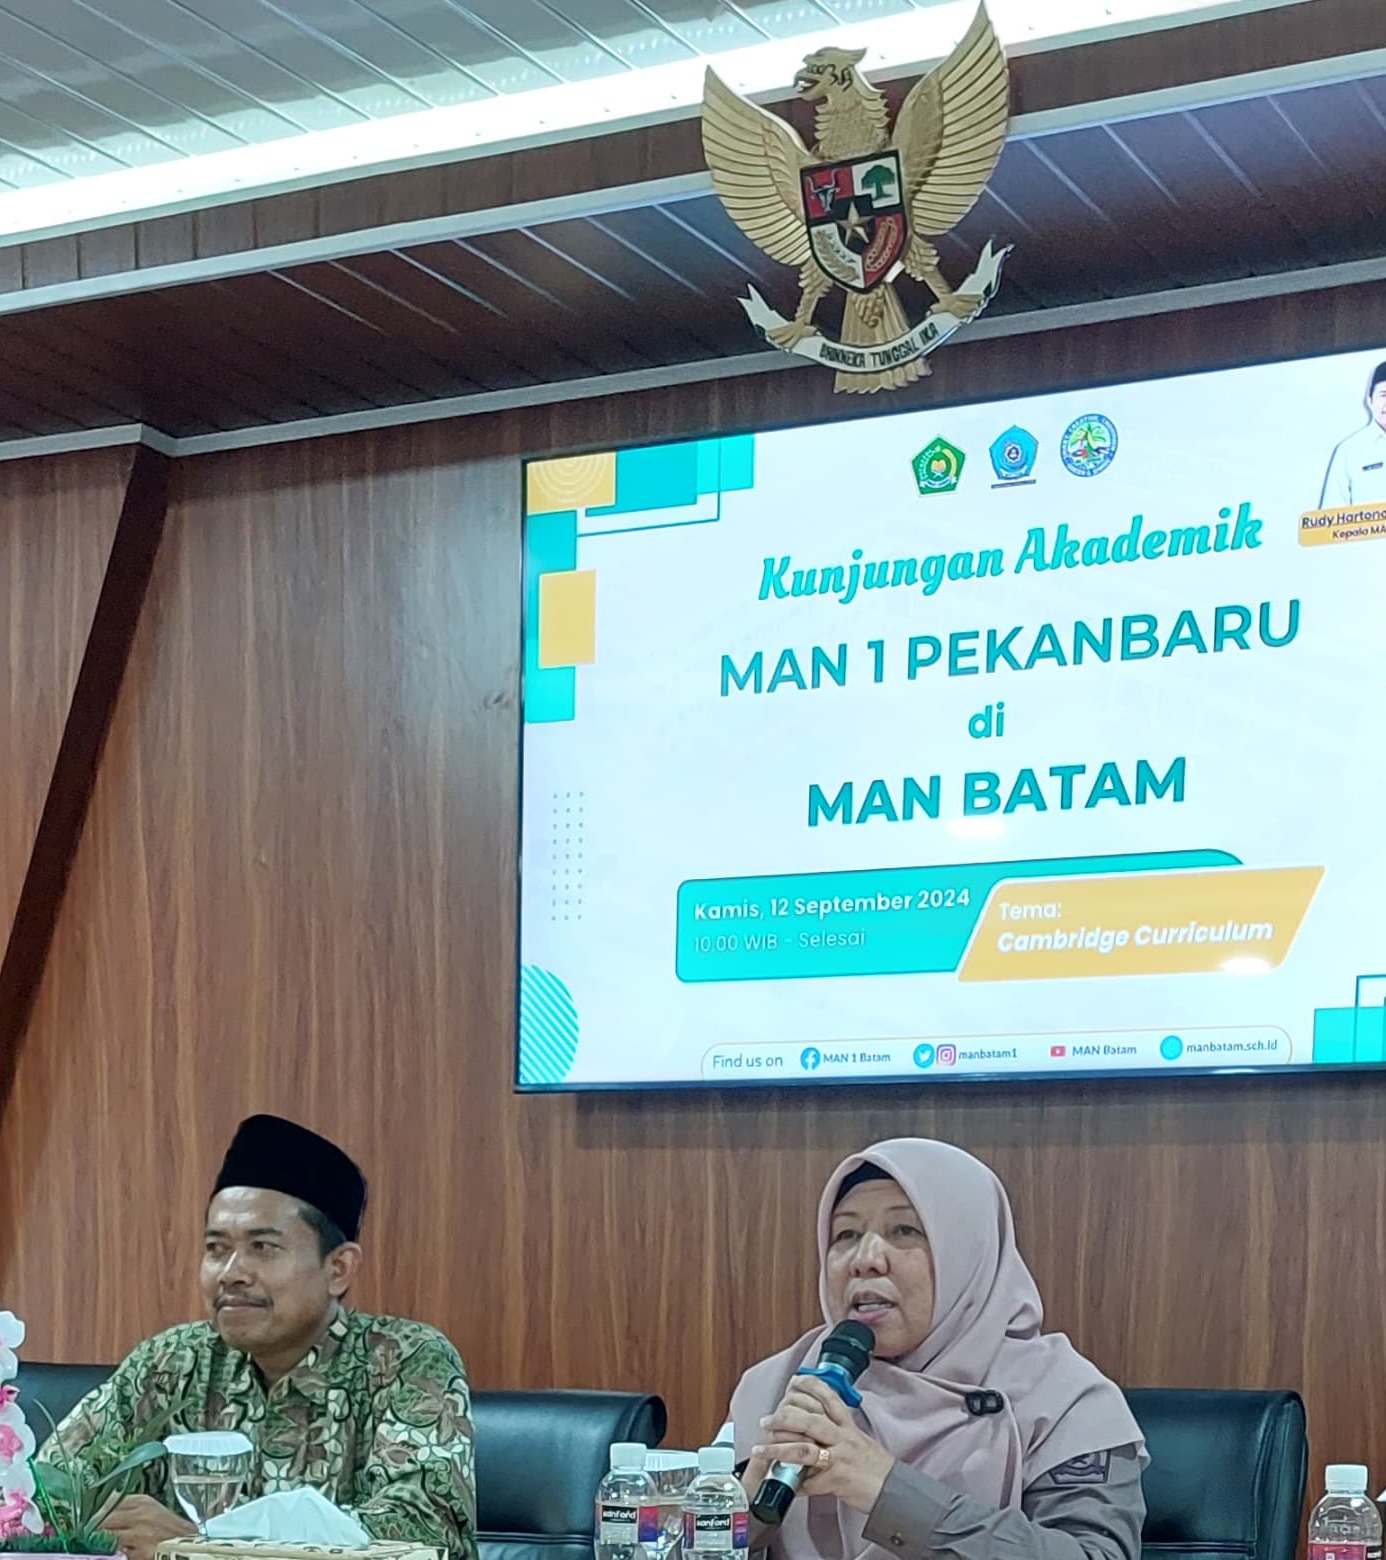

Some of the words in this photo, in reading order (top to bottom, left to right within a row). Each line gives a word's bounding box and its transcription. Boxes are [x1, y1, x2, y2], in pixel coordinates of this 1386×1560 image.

[1301, 514, 1335, 529] Rudy
[1332, 526, 1369, 541] Kepala
[759, 548, 1004, 605] Kunjungan
[1014, 502, 1264, 574] Akademik
[720, 642, 848, 697] MAN
[867, 639, 885, 683] 1
[907, 599, 1301, 681] PEKANBARU
[968, 701, 1005, 738] di
[808, 774, 941, 827] MAN
[963, 756, 1186, 817] BATAM
[694, 898, 763, 921] Kamis,
[770, 897, 789, 917] 12
[794, 891, 913, 920] September
[917, 887, 971, 910] 2024
[999, 902, 1062, 921] Tema:
[745, 932, 778, 950] WIB
[798, 927, 866, 948] Selesai
[997, 925, 1129, 953] Cambridge
[1134, 920, 1274, 946] Curriculum
[823, 1052, 850, 1064] MAN
[859, 1052, 891, 1063] Batam
[1072, 1045, 1101, 1057] MAN
[1103, 1043, 1138, 1056] Batam
[712, 1054, 742, 1070] Find
[746, 1057, 762, 1068] us
[765, 1056, 784, 1068] on
